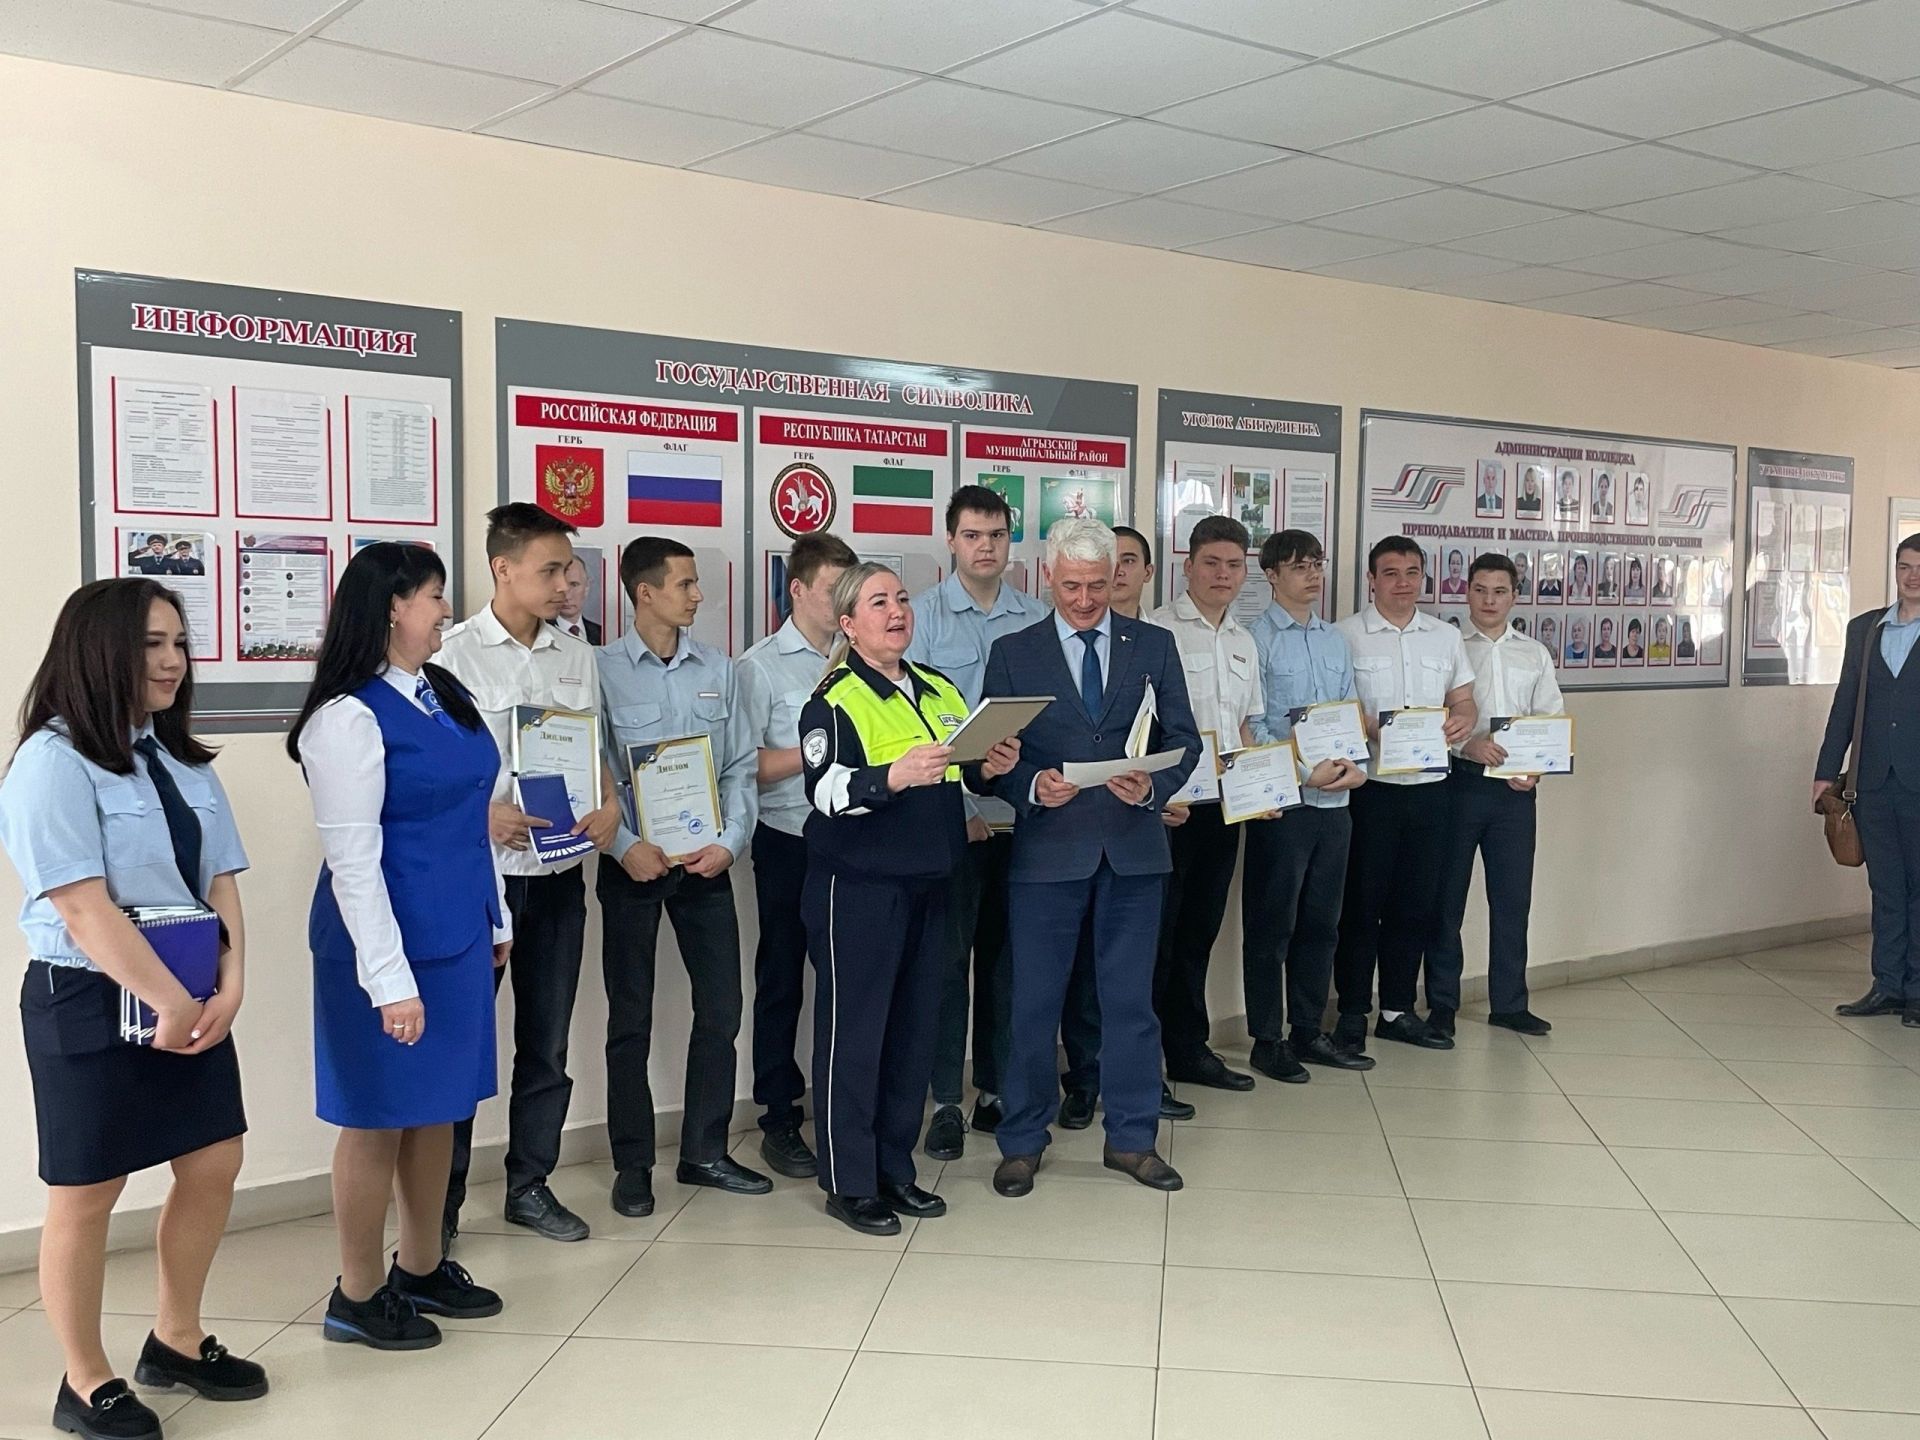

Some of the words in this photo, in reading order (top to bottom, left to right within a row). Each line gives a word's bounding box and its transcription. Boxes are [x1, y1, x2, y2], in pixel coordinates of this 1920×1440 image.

[131, 303, 417, 357] ИНФОРМАЦИЯ
[656, 359, 890, 402] ГОСУДАРСТВЕННАЯ
[902, 384, 1033, 415] СИМВОЛИКА
[540, 402, 636, 427] РОССИЙСКАЯ
[640, 410, 717, 433] ФЕДЕРАЦИЯ
[1182, 411, 1233, 430] УГОЛОК
[1236, 416, 1321, 437] АБИТУРИЕНТА
[558, 434, 583, 445] ГЕРБ
[783, 422, 861, 443] РЕСПУБЛИКА
[863, 428, 927, 447] ТАТАРСТАН
[1020, 438, 1078, 451] АГРЫЗСКИЙ
[663, 442, 689, 453] ФЛАГ
[793, 451, 815, 460] ГЕРБ
[985, 445, 1077, 461] МУНИЦИПАЛЬНЫЙ
[1078, 450, 1109, 463] РАЙОН
[1495, 441, 1583, 461] АДМИНИСТРАЦИЯ
[1585, 449, 1636, 466] КОЛЛЕДЖА
[883, 457, 905, 467] ФЛАГ
[992, 464, 1011, 473] ГЕРБ
[1402, 523, 1494, 540] ПРЕПОДАВАТЕЛИ
[1497, 529, 1506, 539] И
[1510, 529, 1554, 541] МАСТЕРА
[1558, 531, 1656, 546] ПРОИЗВОДСТВЕННОГО
[1657, 536, 1703, 548] ОБУЧЕНИЯ
